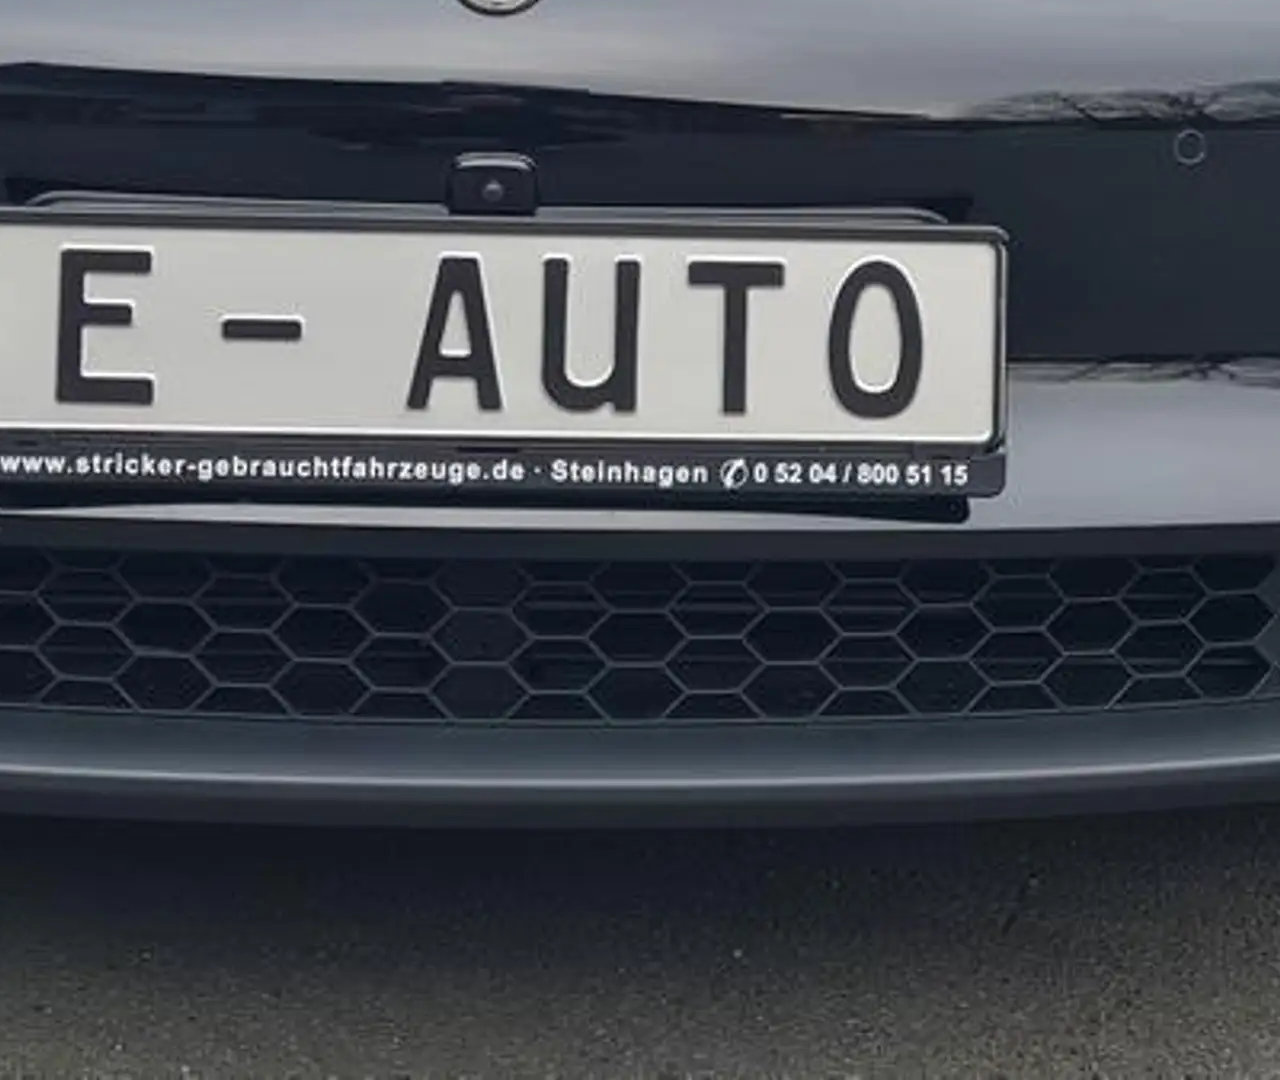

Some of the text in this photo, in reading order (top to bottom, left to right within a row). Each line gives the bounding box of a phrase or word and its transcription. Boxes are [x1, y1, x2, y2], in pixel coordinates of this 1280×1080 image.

[56, 248, 922, 420] E - AUTO
[0, 452, 525, 486] www.stricker-gebrauchtfahrzeuge.de
[549, 458, 709, 489] Steinhagen
[752, 461, 769, 484] 0
[774, 461, 802, 484] 52
[809, 462, 837, 485] 04
[856, 462, 900, 486] 800
[905, 463, 931, 487] 51
[940, 463, 969, 487] 15
